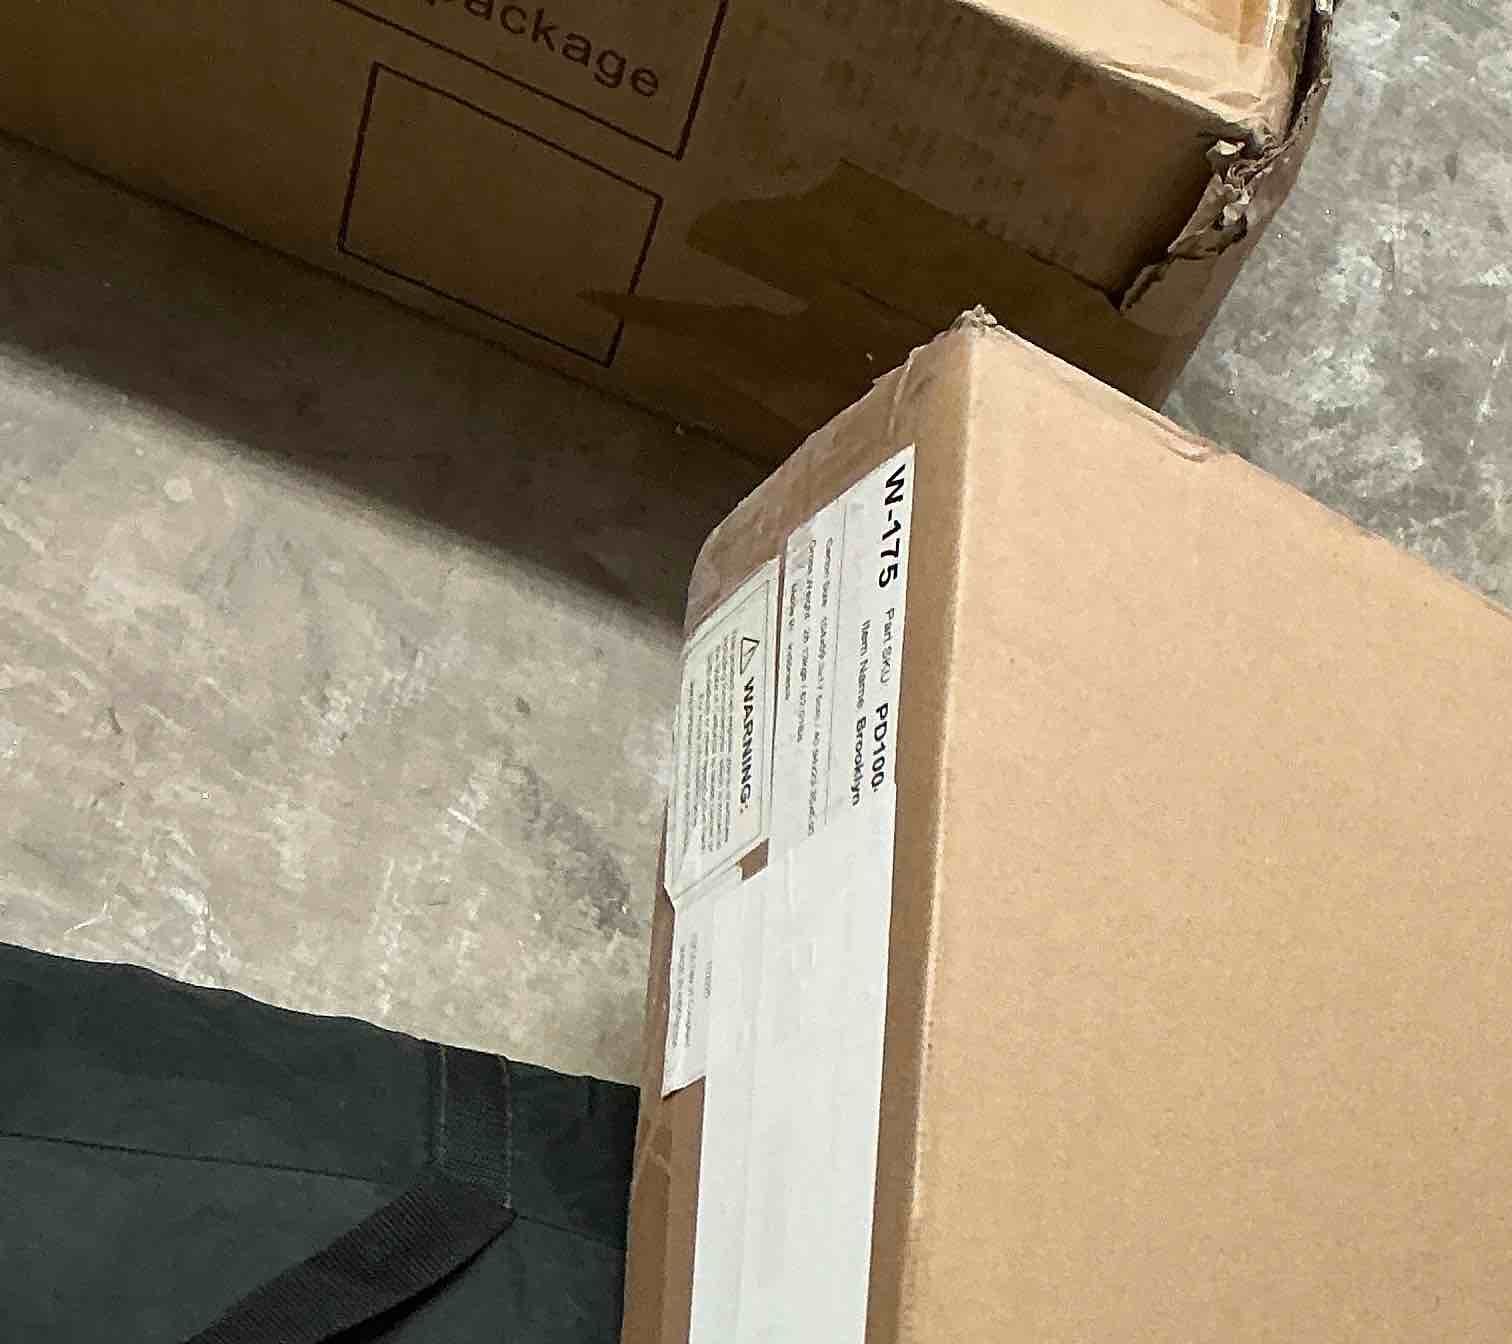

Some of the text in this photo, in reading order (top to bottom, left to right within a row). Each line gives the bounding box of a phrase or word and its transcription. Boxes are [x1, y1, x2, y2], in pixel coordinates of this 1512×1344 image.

[427, 0, 660, 97] ackage
[877, 464, 905, 588] W-175
[850, 716, 866, 806] Brooklyn
